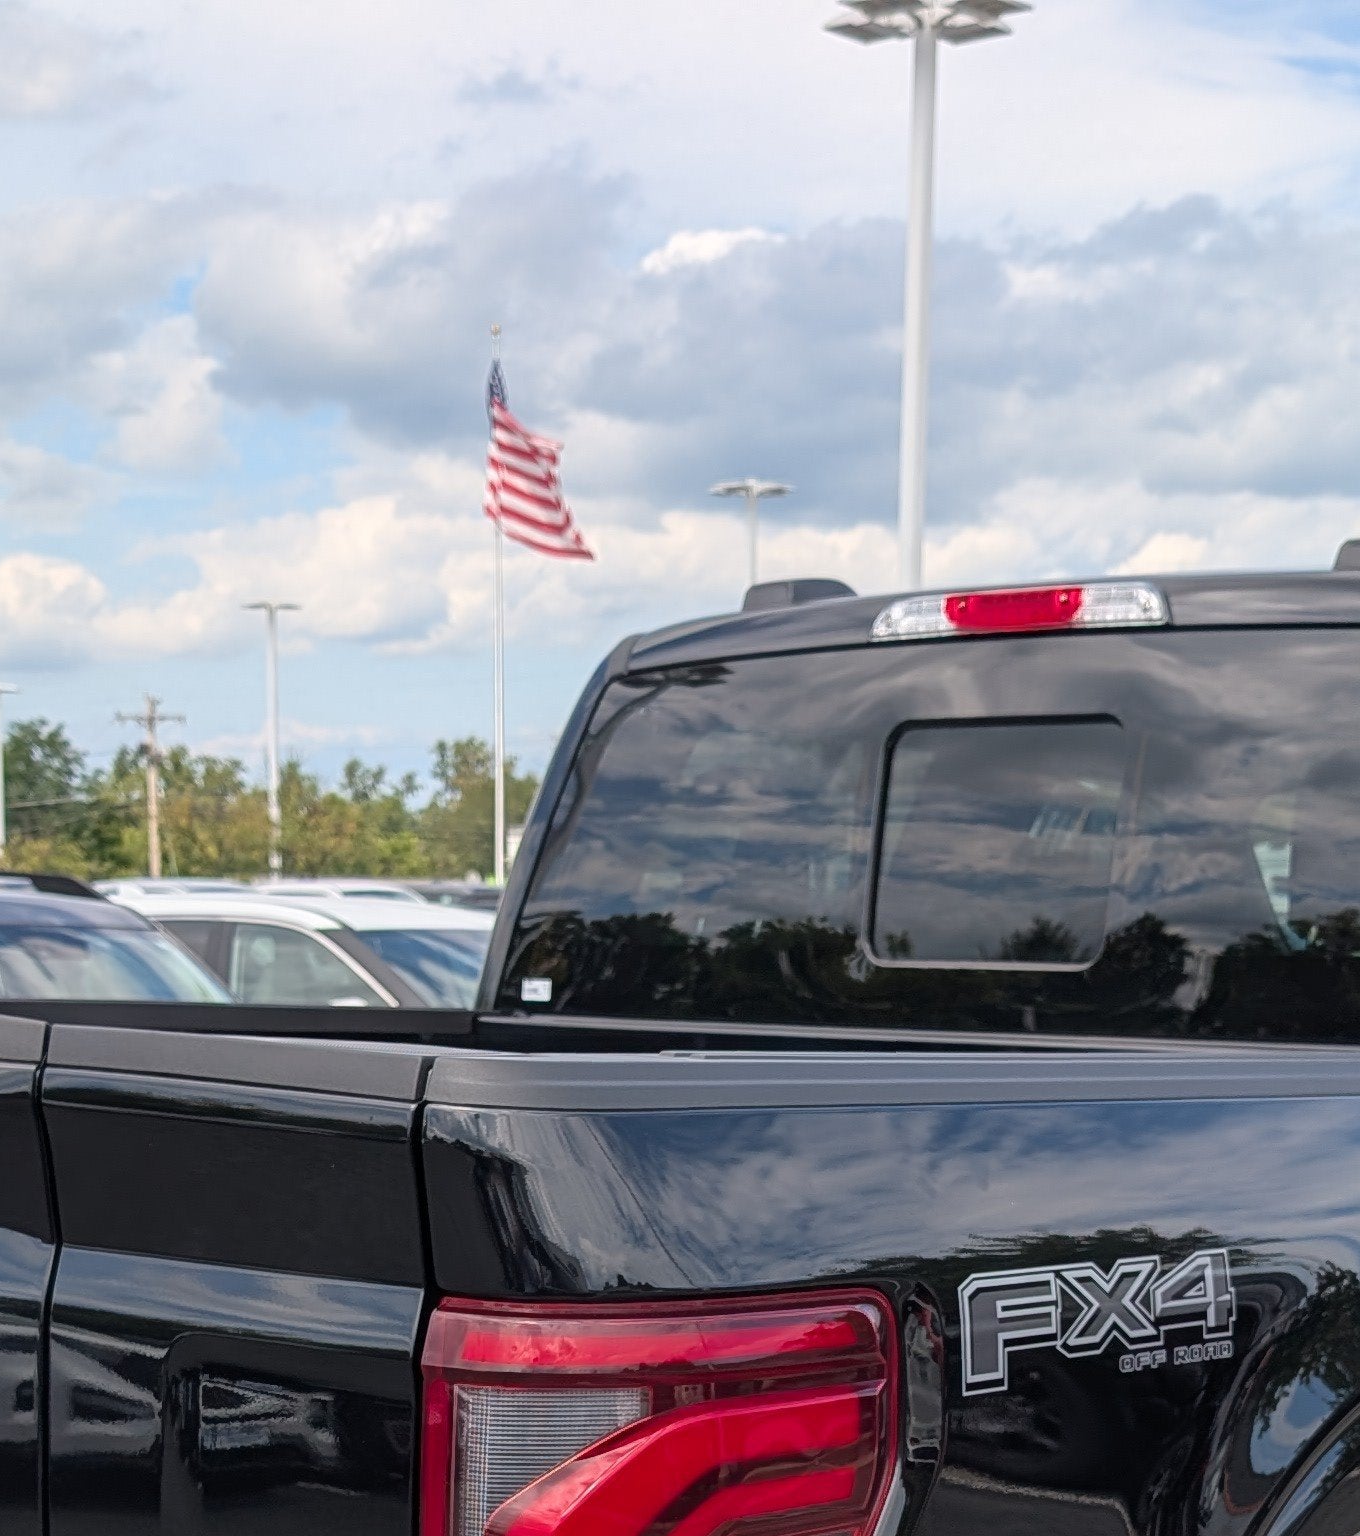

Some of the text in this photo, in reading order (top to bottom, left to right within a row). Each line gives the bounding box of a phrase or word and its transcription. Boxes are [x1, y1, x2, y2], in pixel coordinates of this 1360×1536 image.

[957, 1249, 1235, 1396] FX4
[1119, 1340, 1234, 1374] OFF ROAD
